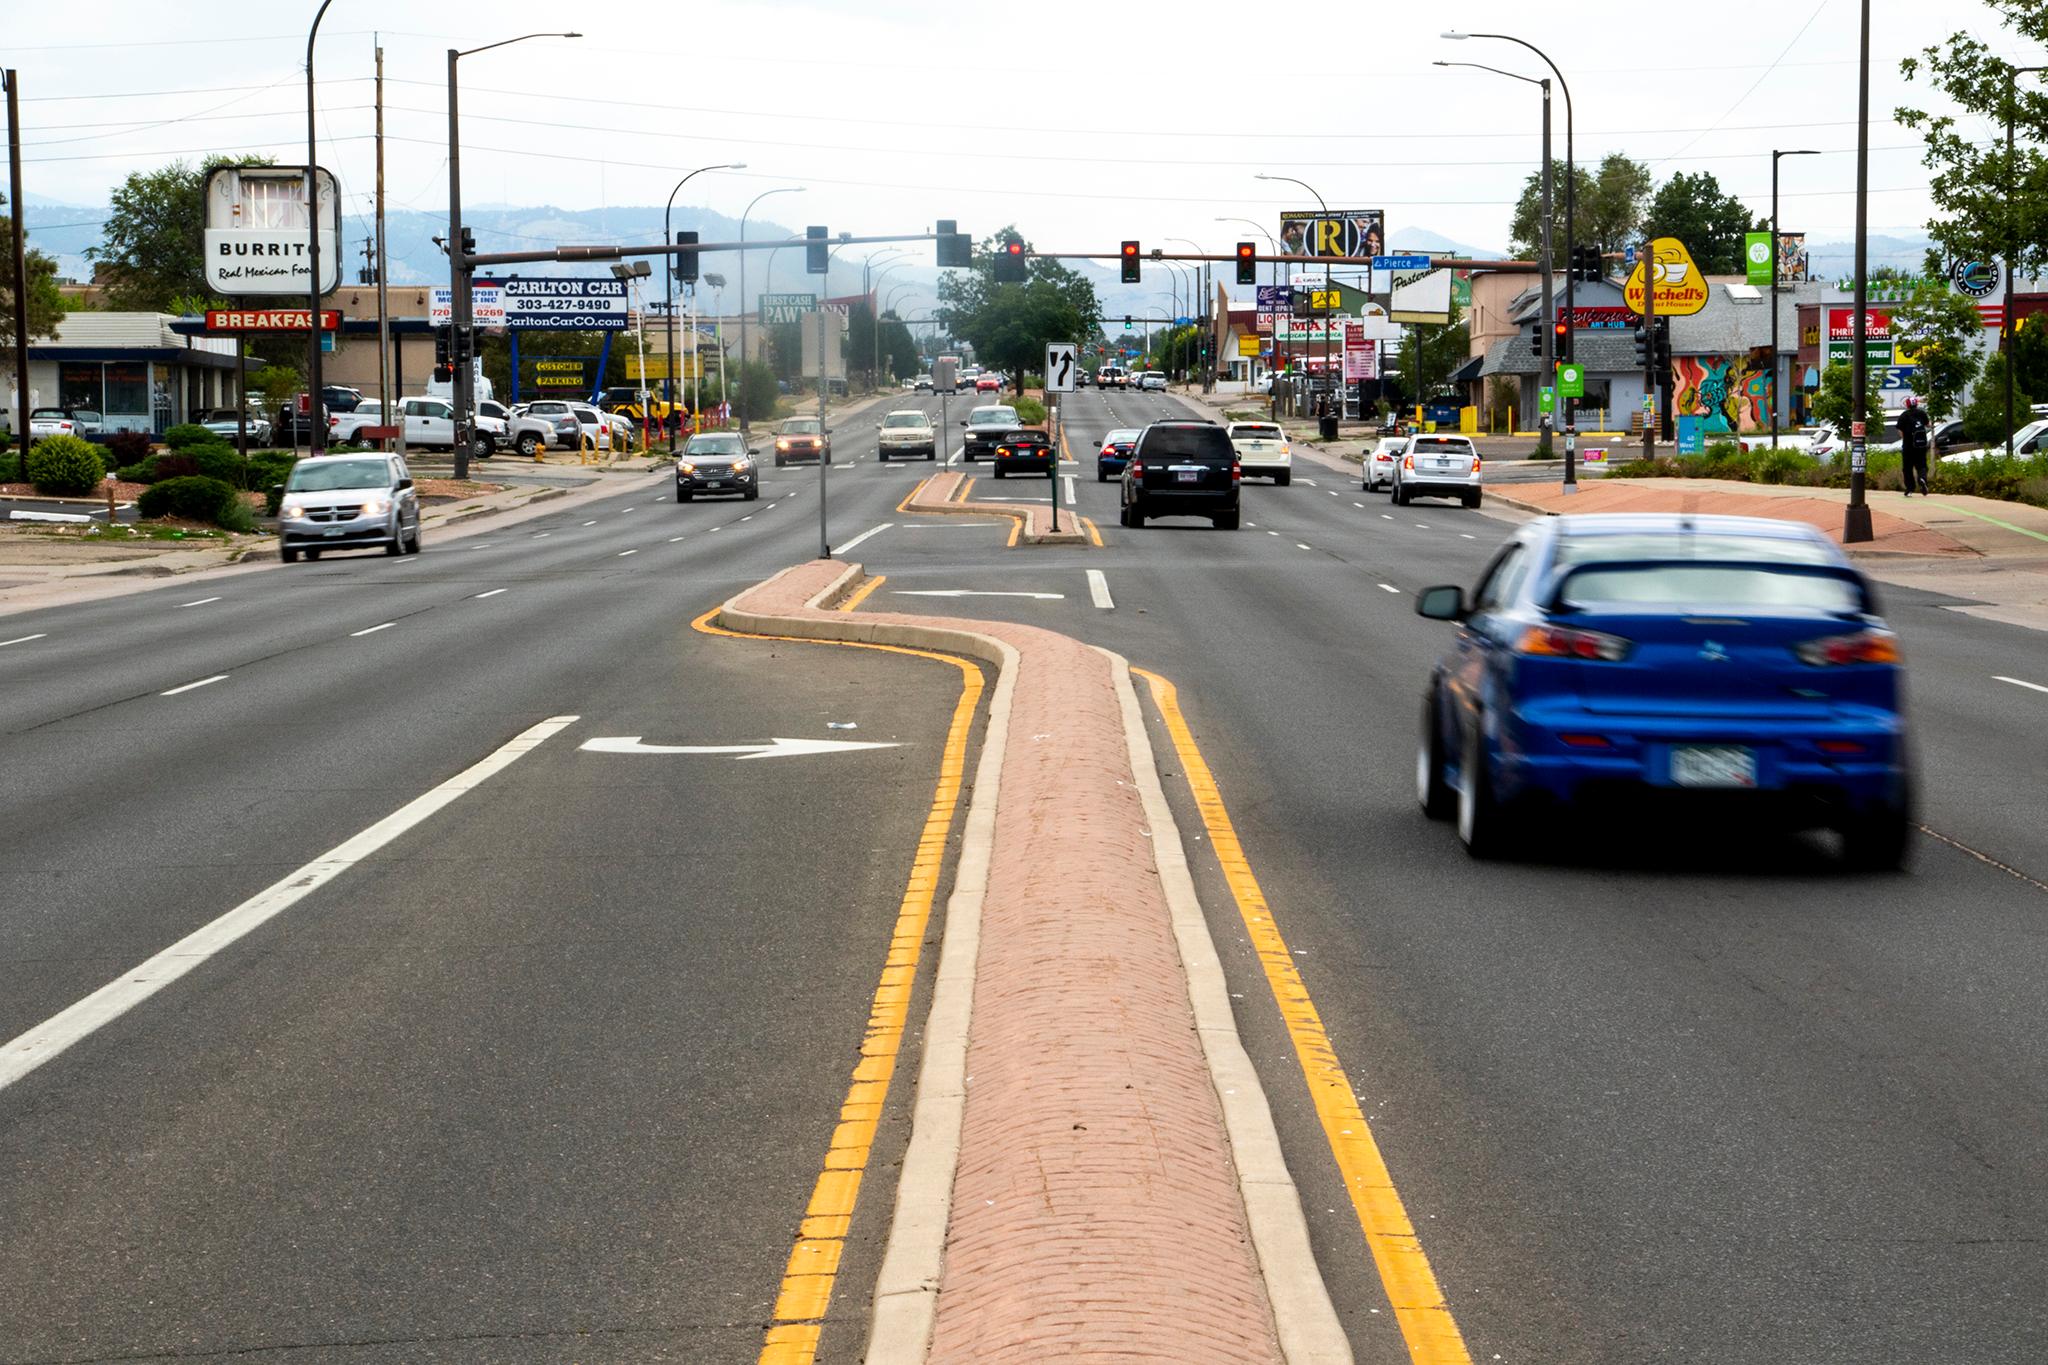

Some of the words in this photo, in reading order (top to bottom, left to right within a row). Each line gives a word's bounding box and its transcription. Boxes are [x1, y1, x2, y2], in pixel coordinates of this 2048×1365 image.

[1317, 220, 1345, 256] R
[1383, 258, 1412, 268] Pierce
[219, 266, 242, 280] Real
[245, 267, 289, 279] Mexican
[292, 263, 313, 275] Foo
[505, 281, 583, 295] CARLTON
[587, 281, 622, 295] CAR
[517, 299, 611, 310] 303-427-9490
[790, 295, 812, 305] CASH
[505, 316, 625, 327] CarltonCarCO.com
[1867, 350, 1890, 358] TREE
[538, 362, 583, 370] CUSTOMER
